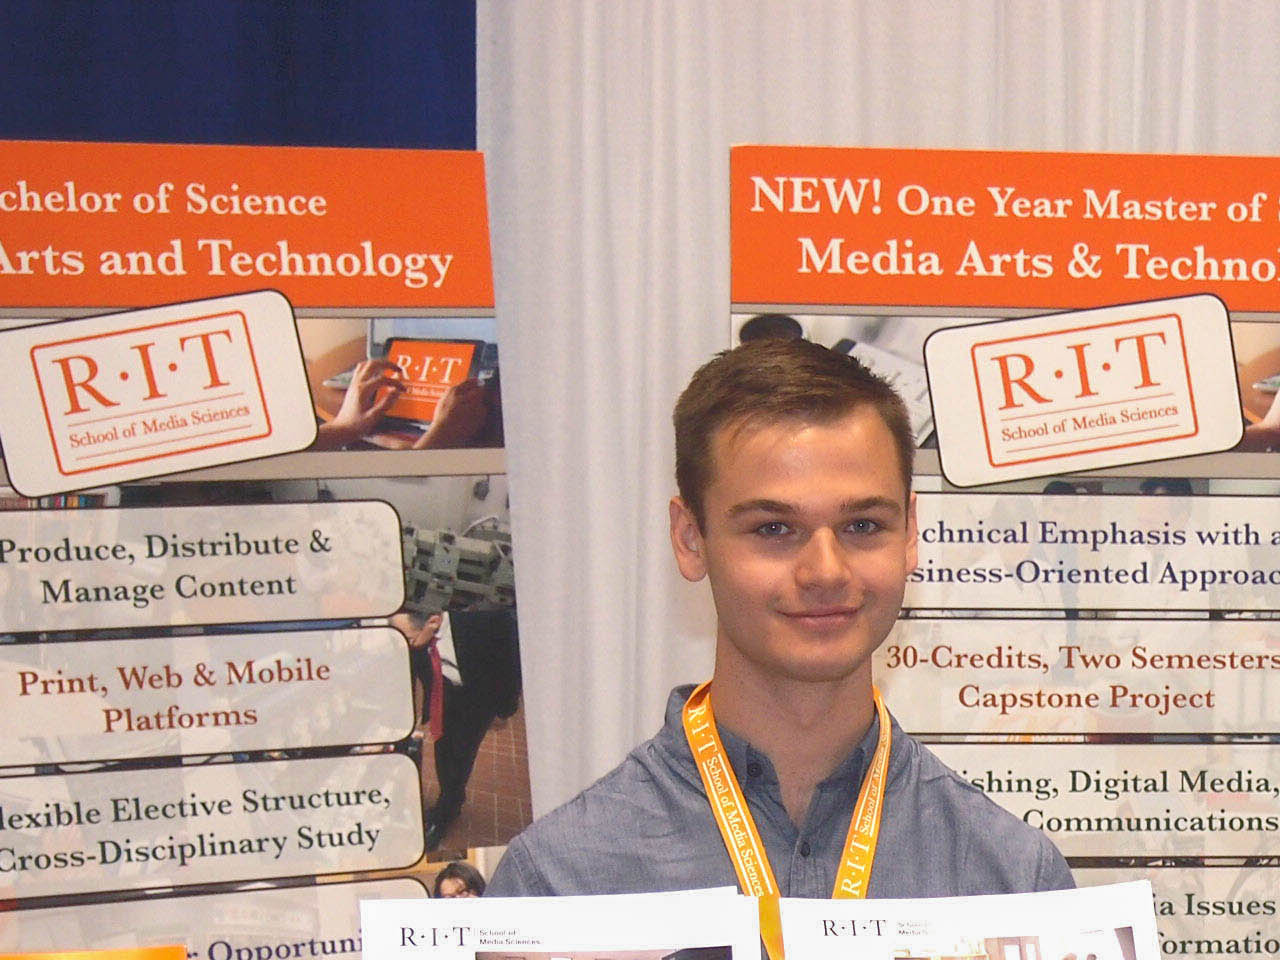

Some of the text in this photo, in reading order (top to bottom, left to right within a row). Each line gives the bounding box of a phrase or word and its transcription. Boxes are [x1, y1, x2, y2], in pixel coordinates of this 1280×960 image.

[0, 180, 328, 216] chelor of Science
[750, 177, 883, 216] NEW!
[897, 184, 976, 219] One
[987, 186, 1073, 220] Year
[1083, 189, 1213, 223] Master
[1226, 192, 1268, 223] of
[0, 238, 454, 288] Arts and Technology
[797, 238, 944, 277] Media
[955, 242, 1055, 279] Arts
[1067, 243, 1103, 279] &
[69, 404, 251, 449] School of Media Sciences
[1001, 404, 1179, 442] School of Media Sciences
[0, 528, 333, 566] Produce, Distribute &
[917, 519, 1030, 545] chnical
[1037, 520, 1187, 552] Emphasis
[1196, 520, 1261, 546] with
[905, 559, 1150, 586] siness-Oriented
[40, 573, 298, 609] Manage Content
[18, 656, 332, 698] Print, Web & Mobile
[885, 644, 1050, 675] 30-Credits,
[1059, 646, 1123, 671] Two
[957, 685, 1217, 716] Capstone Project
[102, 703, 259, 735] Platforms
[706, 757, 728, 797] School
[954, 770, 1280, 802] shing, Digital Media,
[0, 784, 393, 831] lexible Elective Structure,
[720, 792, 736, 809] of
[859, 799, 876, 835] School
[726, 807, 746, 850] Media
[1022, 808, 1280, 834] Communications
[0, 822, 382, 873] Cross-Disciplinary Study
[740, 848, 764, 897] Sciences
[1184, 893, 1278, 917] Issues
[479, 938, 541, 946] Media Sciences
